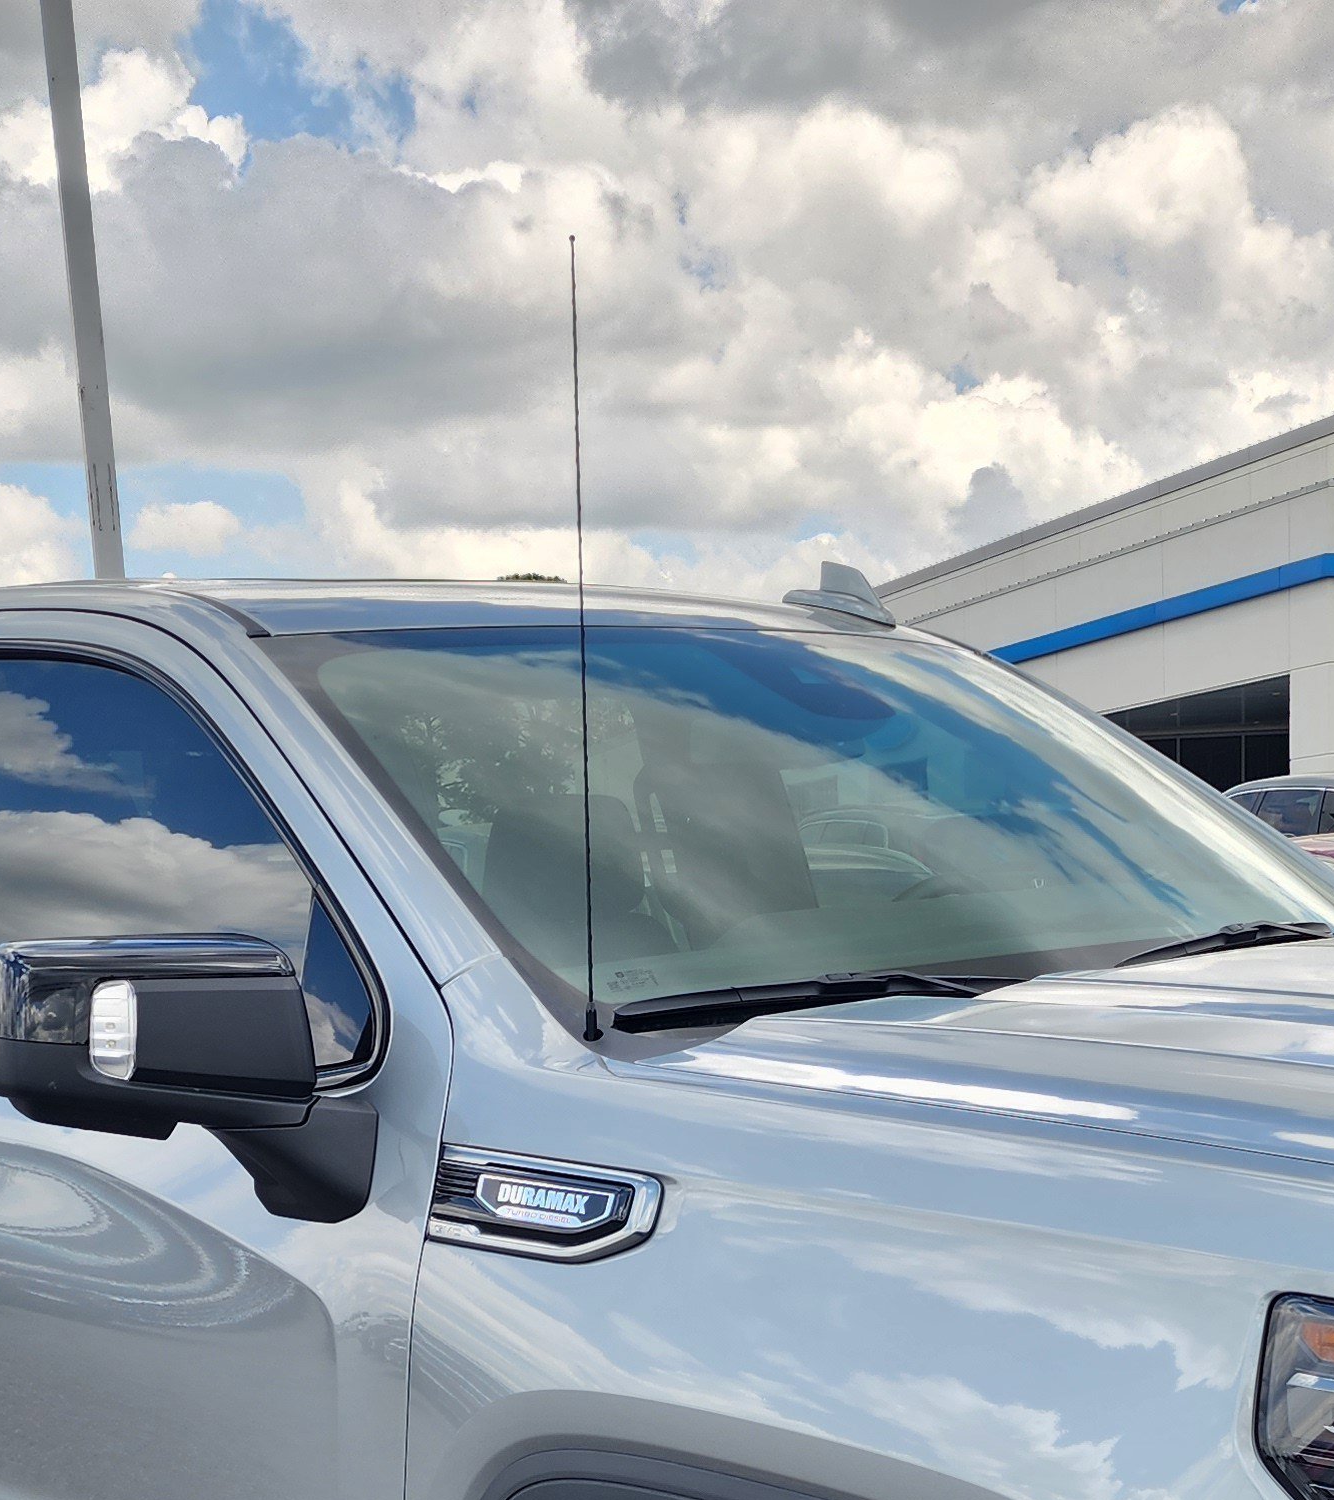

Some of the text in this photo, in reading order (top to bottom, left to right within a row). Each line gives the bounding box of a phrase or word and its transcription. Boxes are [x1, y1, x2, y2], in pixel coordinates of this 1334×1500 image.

[497, 1182, 589, 1215] DURAMAX
[507, 1208, 571, 1223] TURBO DIESEL
